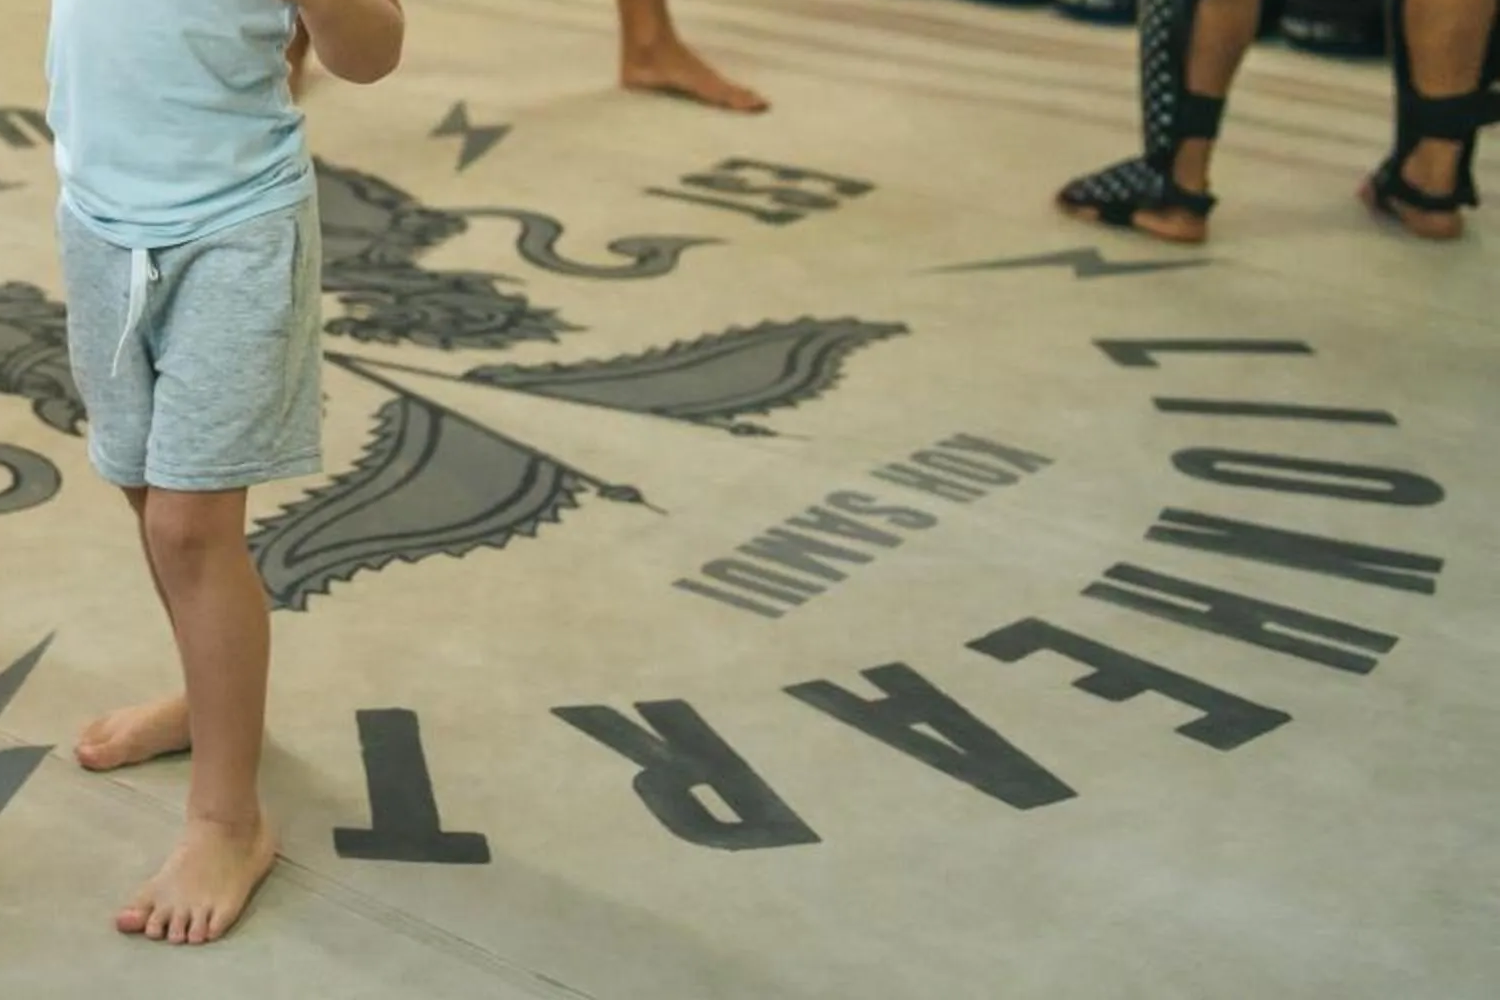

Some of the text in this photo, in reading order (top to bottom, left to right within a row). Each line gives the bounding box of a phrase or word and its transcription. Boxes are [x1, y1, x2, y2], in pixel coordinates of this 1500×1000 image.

[332, 339, 1447, 866] LIONHEART
[671, 432, 1057, 619] KOH SAMUI
